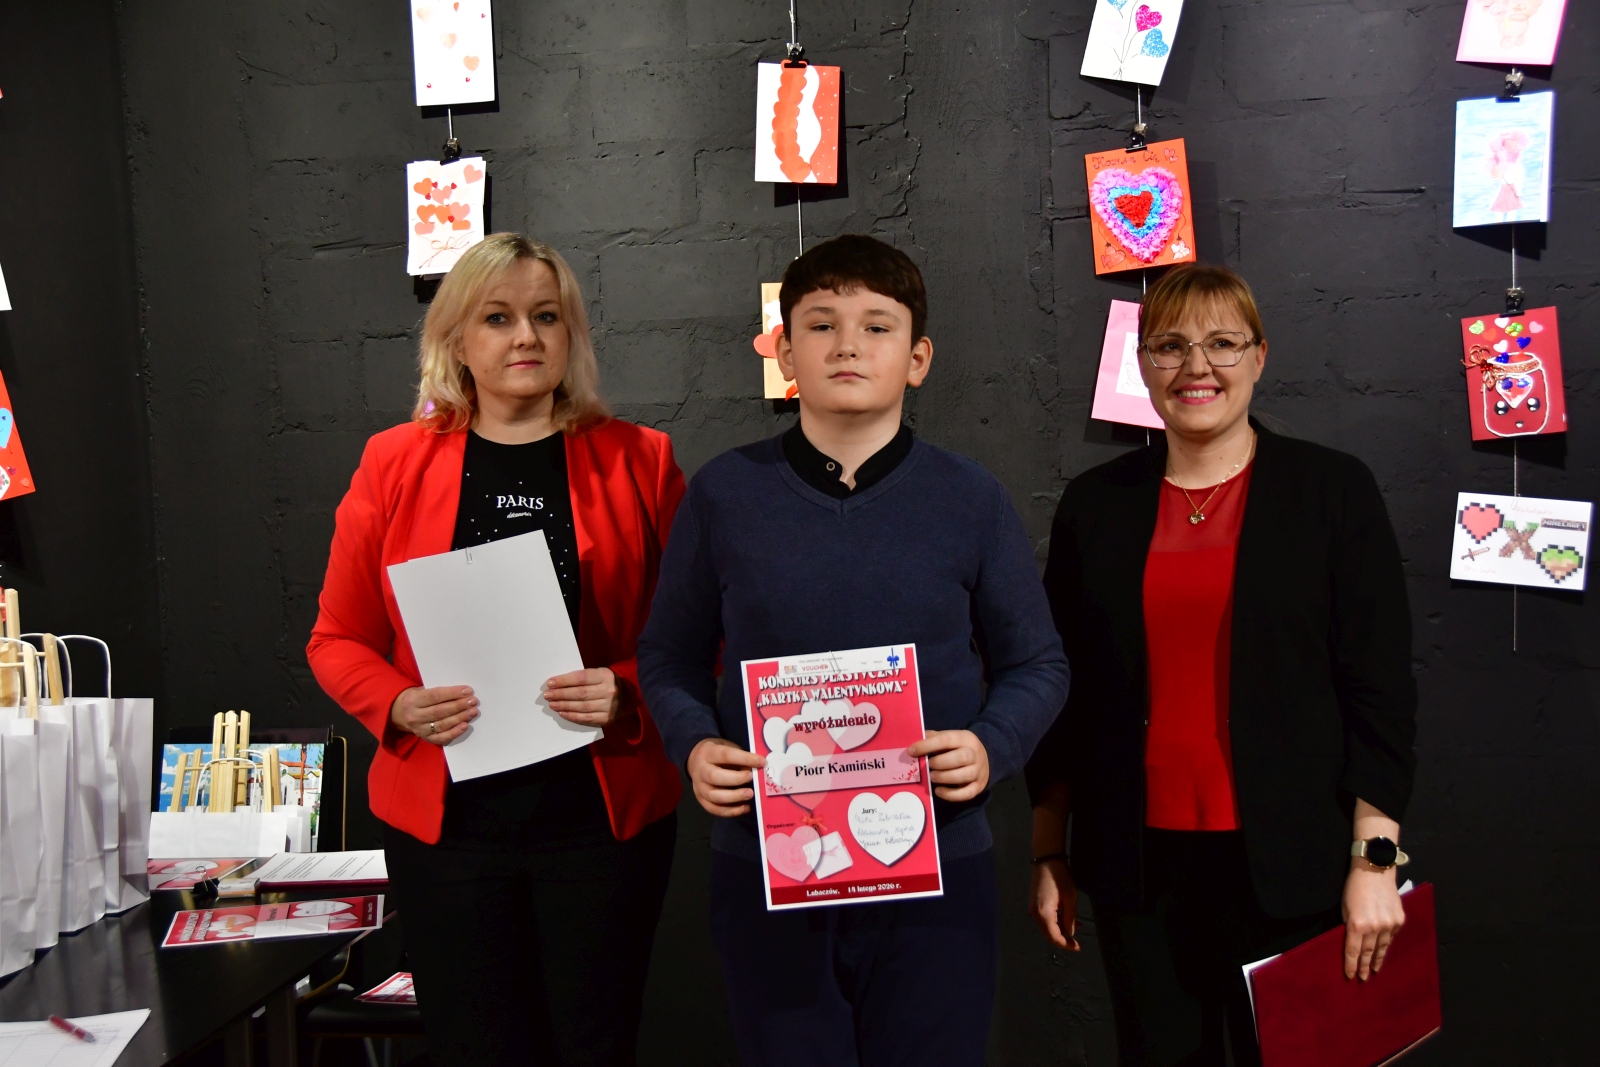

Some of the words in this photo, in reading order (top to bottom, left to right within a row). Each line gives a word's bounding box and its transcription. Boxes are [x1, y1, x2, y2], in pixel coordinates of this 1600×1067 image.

[496, 494, 544, 510] PARIS
[1541, 519, 1586, 529] MINECRAFT
[793, 713, 876, 733] wyróżnienie
[794, 765, 825, 777] Piotr
[828, 757, 886, 774] Kamiński
[857, 885, 876, 893] lutego
